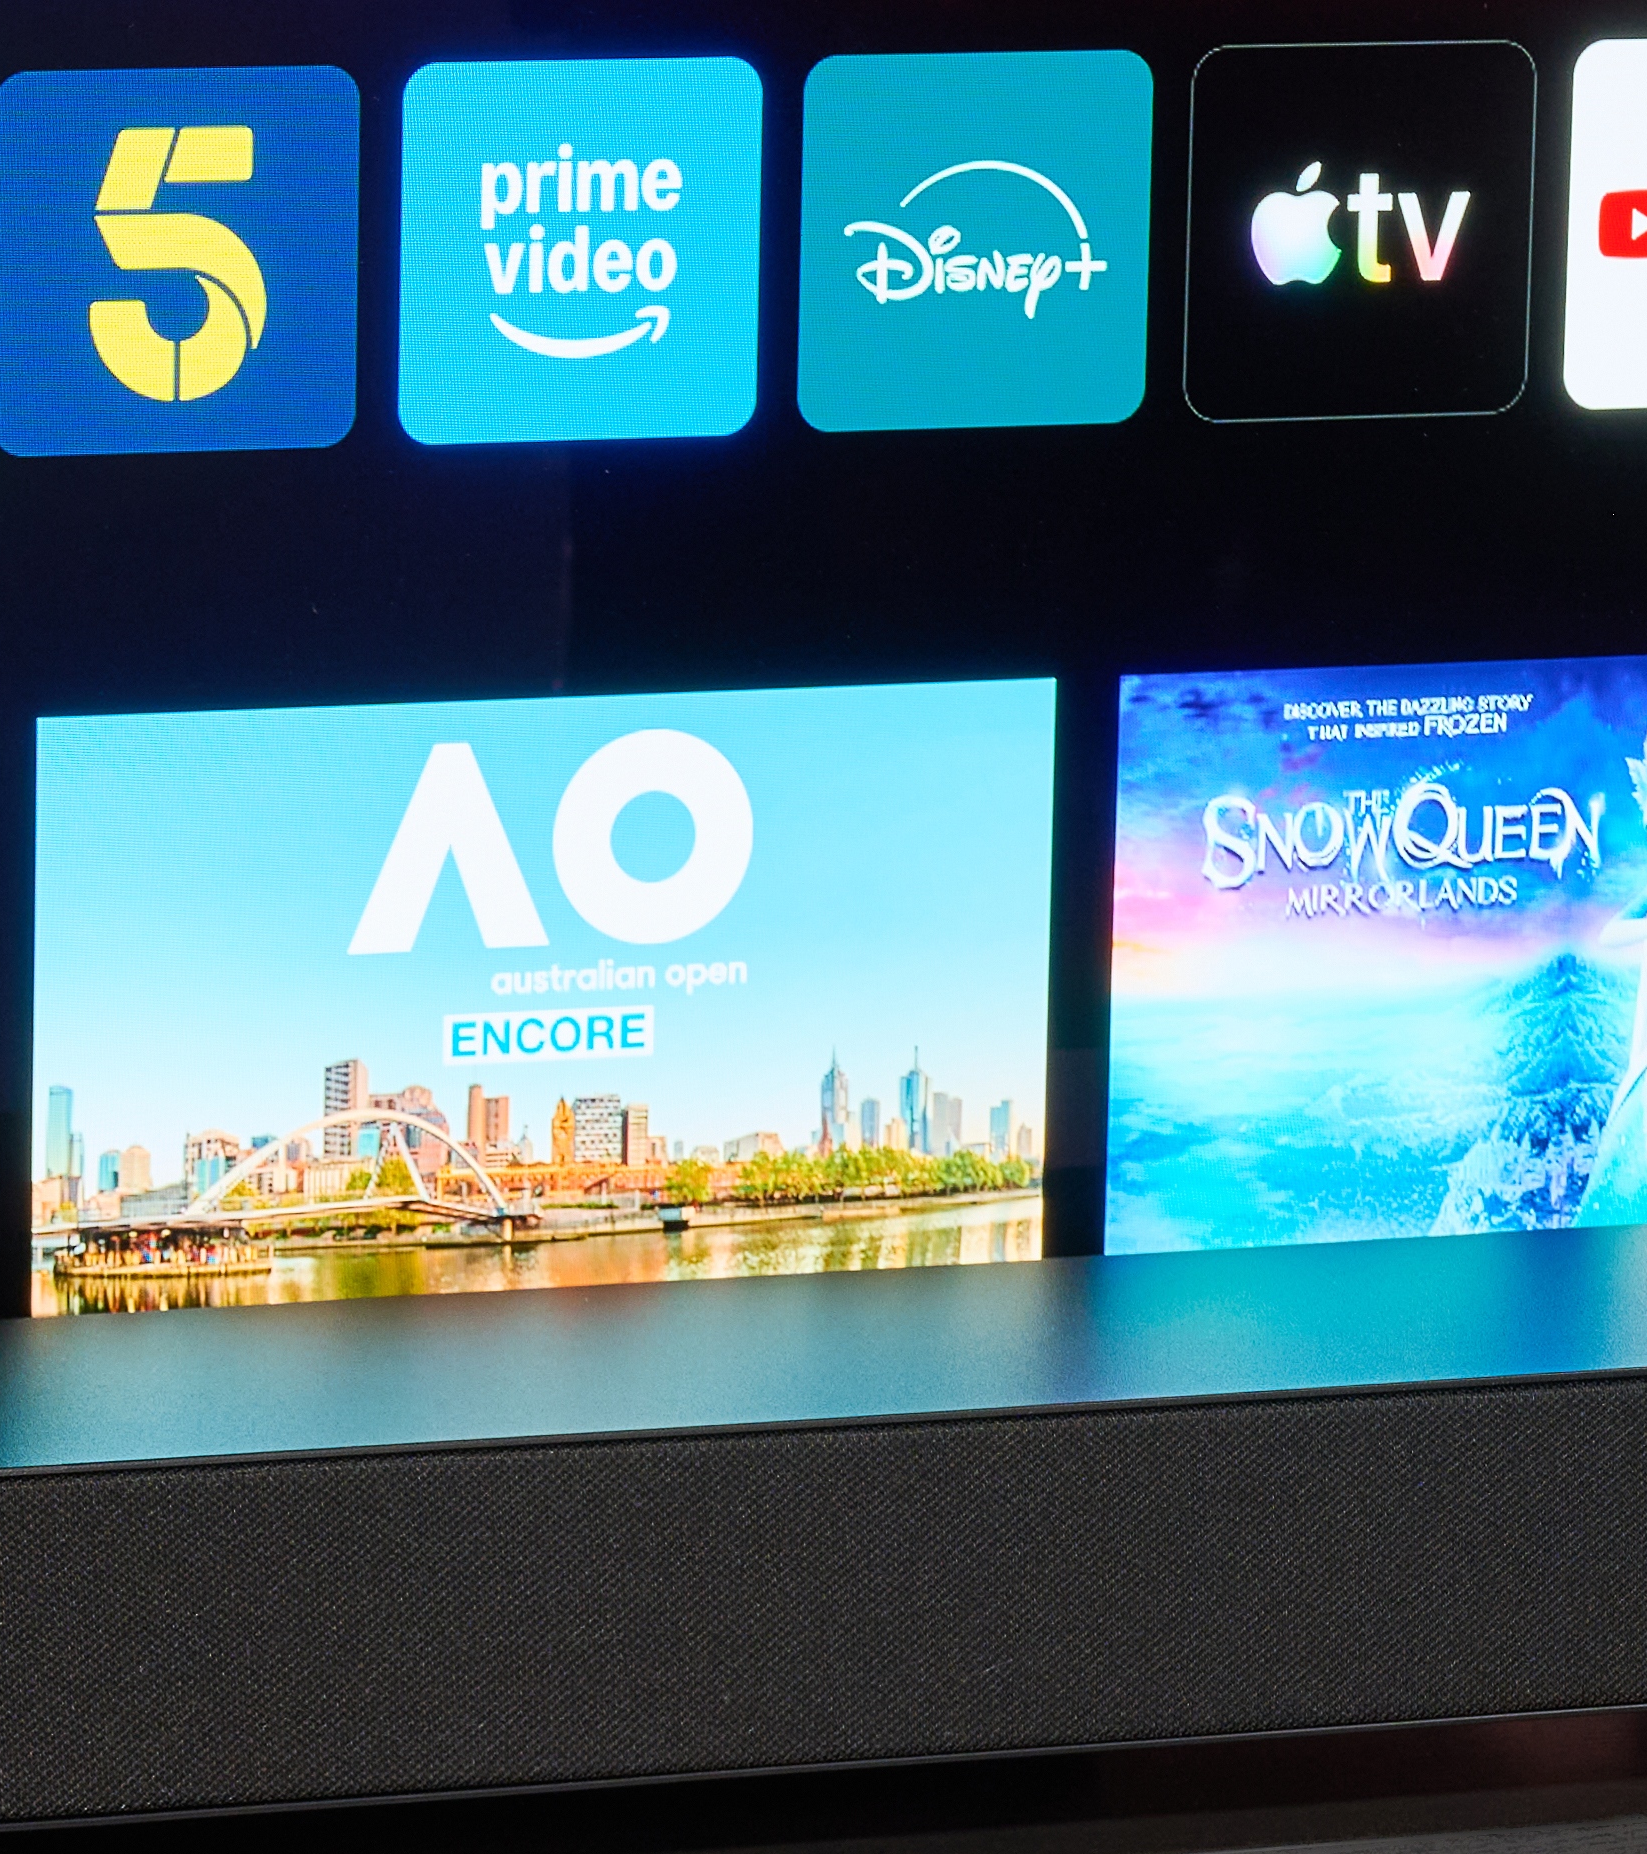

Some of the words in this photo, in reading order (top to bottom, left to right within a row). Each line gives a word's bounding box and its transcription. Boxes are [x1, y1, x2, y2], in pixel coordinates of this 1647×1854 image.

[479, 142, 684, 231] prime
[88, 125, 268, 402] 5
[483, 224, 677, 295] video
[1366, 699, 1398, 718] THE
[1477, 694, 1533, 713] STORY
[1423, 712, 1508, 738] FROZEN
[347, 727, 755, 956] AO
[1202, 793, 1395, 890] SNOW
[1395, 782, 1604, 880] QUEEN
[1284, 874, 1519, 918] MIRRORLANDS
[490, 959, 657, 996] australian
[665, 955, 748, 996] open
[449, 1012, 649, 1059] ENCORE
